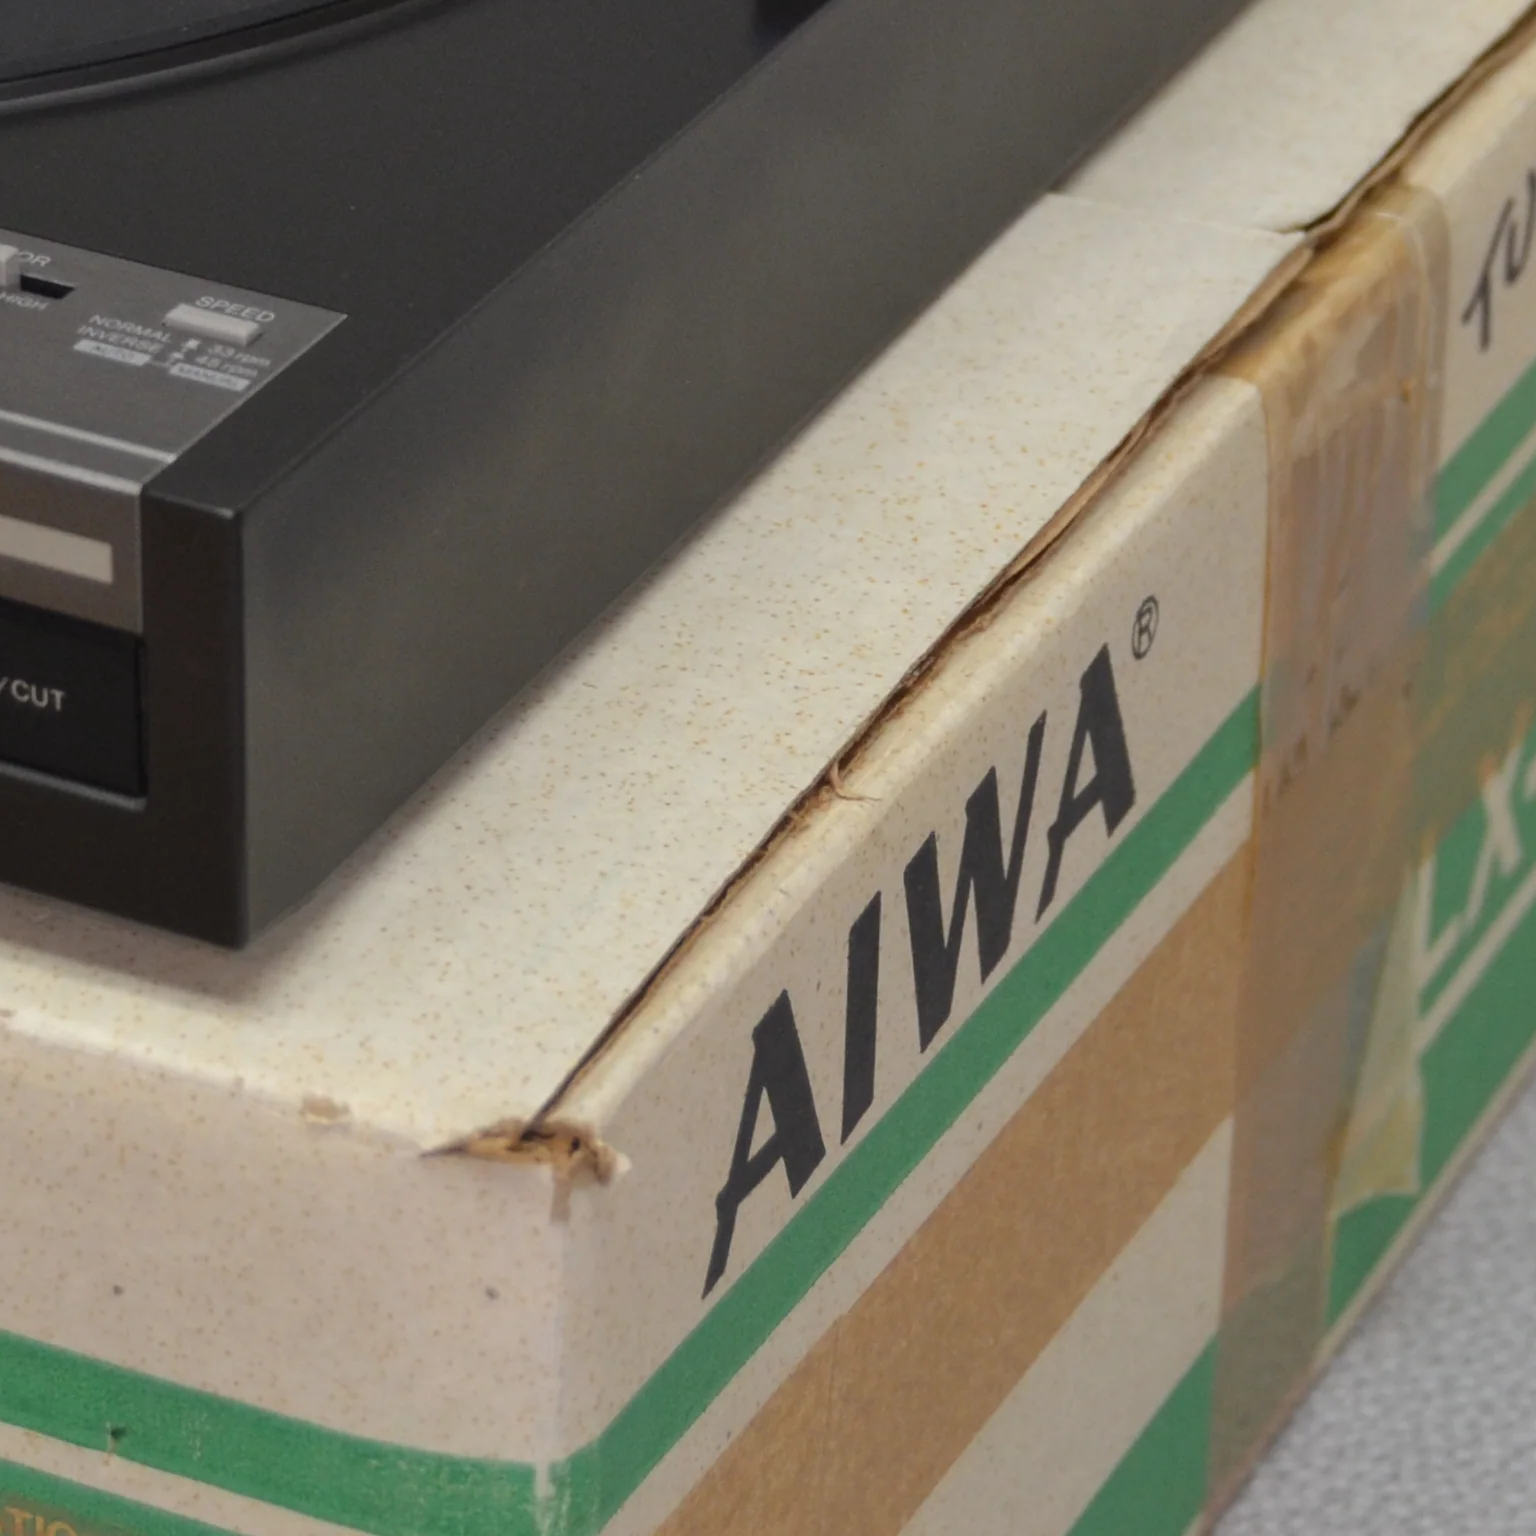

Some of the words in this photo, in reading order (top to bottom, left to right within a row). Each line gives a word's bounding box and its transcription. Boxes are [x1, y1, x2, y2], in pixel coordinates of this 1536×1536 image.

[194, 295, 277, 324] SPEED
[88, 313, 173, 344] NORMAL
[701, 642, 1138, 1300] AIWA
